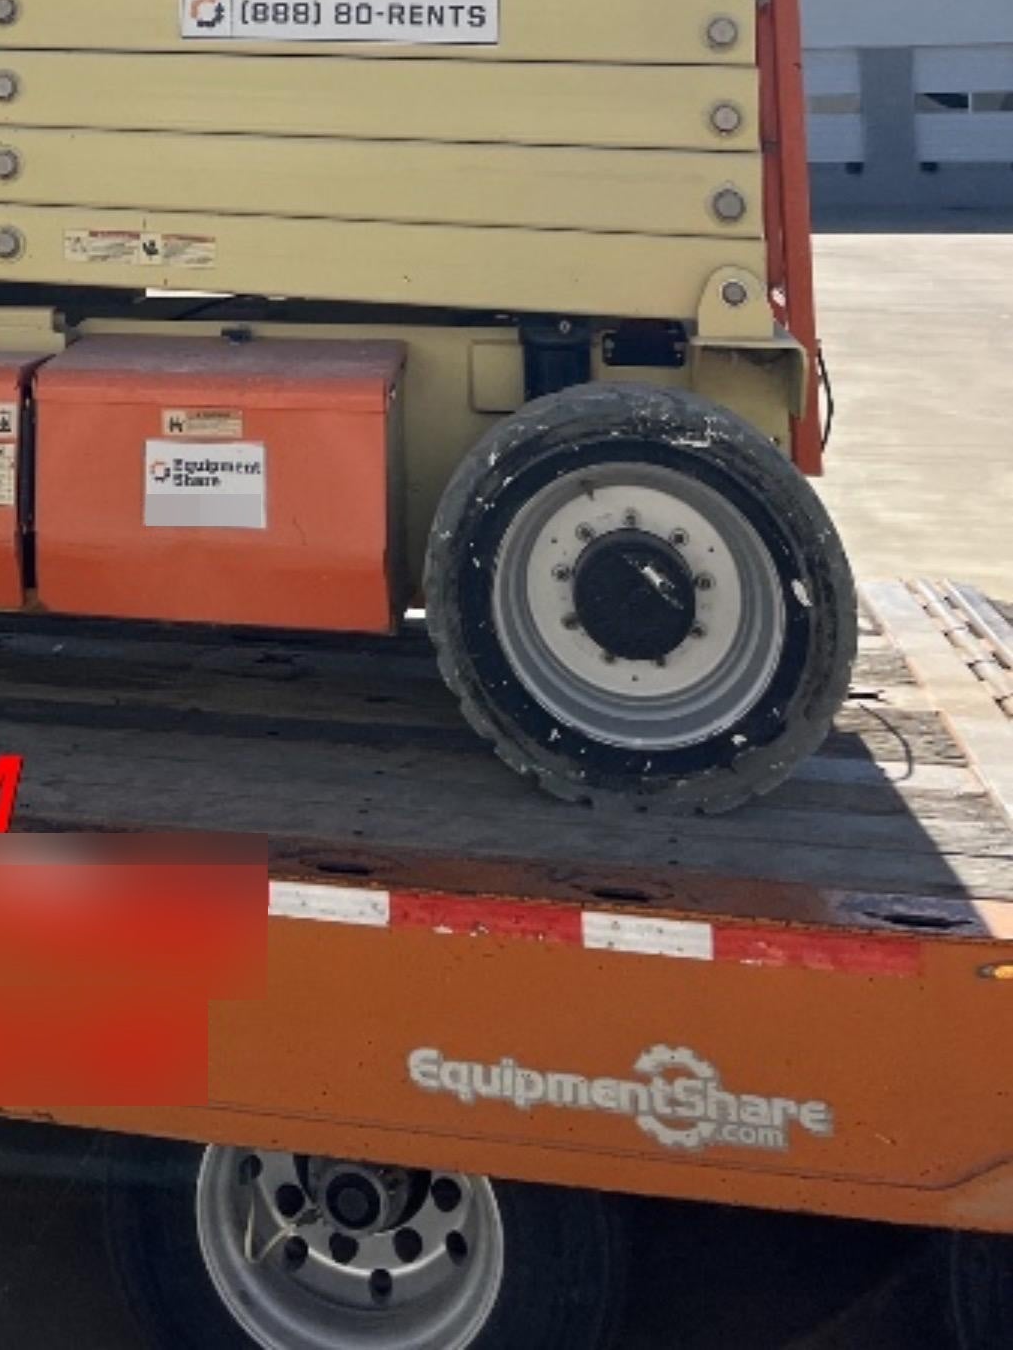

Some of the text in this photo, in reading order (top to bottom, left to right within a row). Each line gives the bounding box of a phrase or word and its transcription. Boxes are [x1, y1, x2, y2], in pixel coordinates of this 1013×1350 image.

[240, 0, 488, 28] (888) 80-RENTS
[406, 1047, 834, 1139] EquipmentShare
